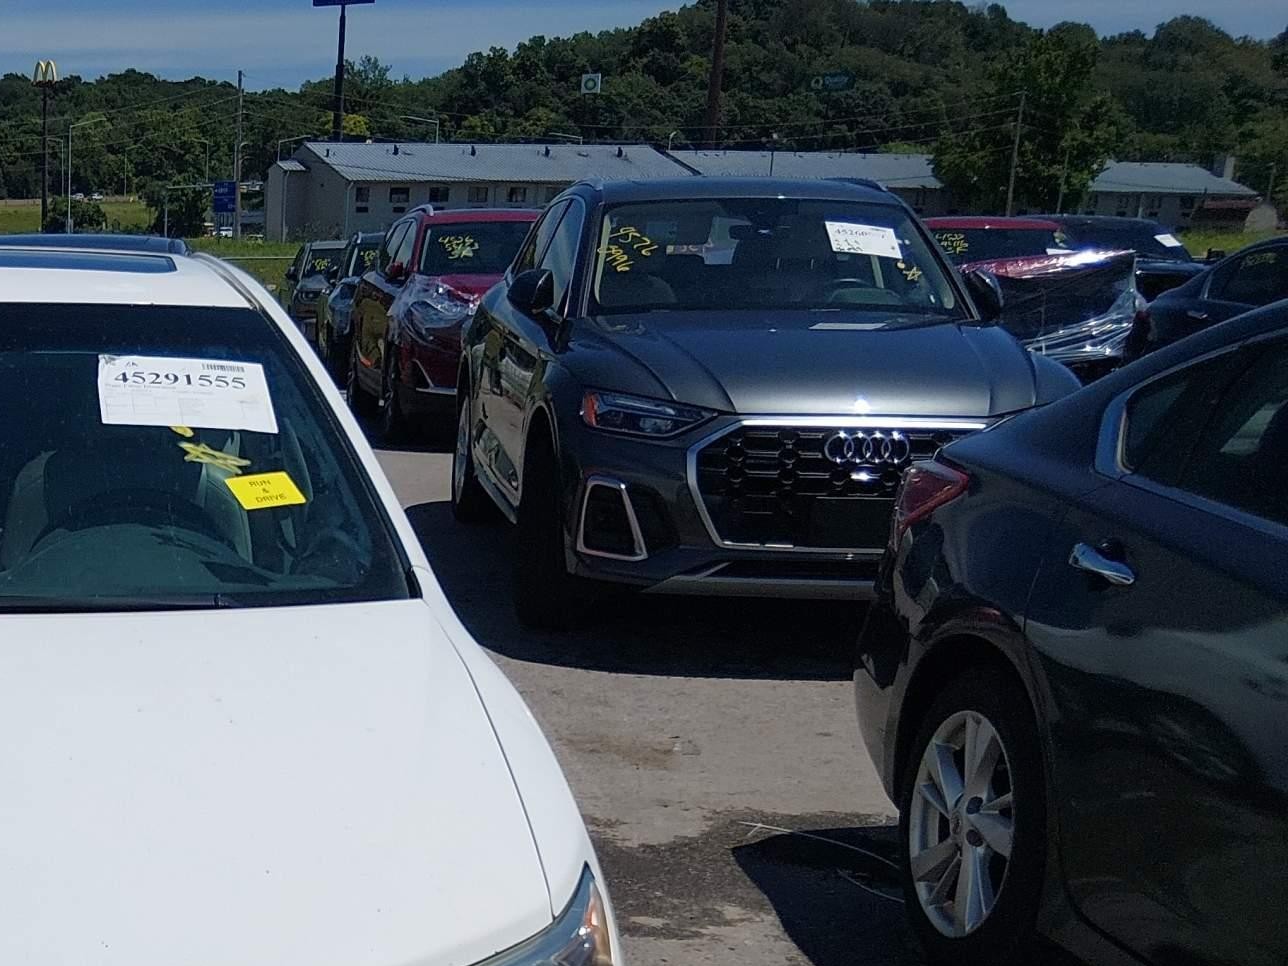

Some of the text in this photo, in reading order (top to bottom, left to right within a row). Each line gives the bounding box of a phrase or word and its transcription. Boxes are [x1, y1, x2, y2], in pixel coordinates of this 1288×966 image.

[114, 371, 247, 390] 45291555
[248, 479, 272, 487] RUN
[255, 493, 288, 503] DRIVE
